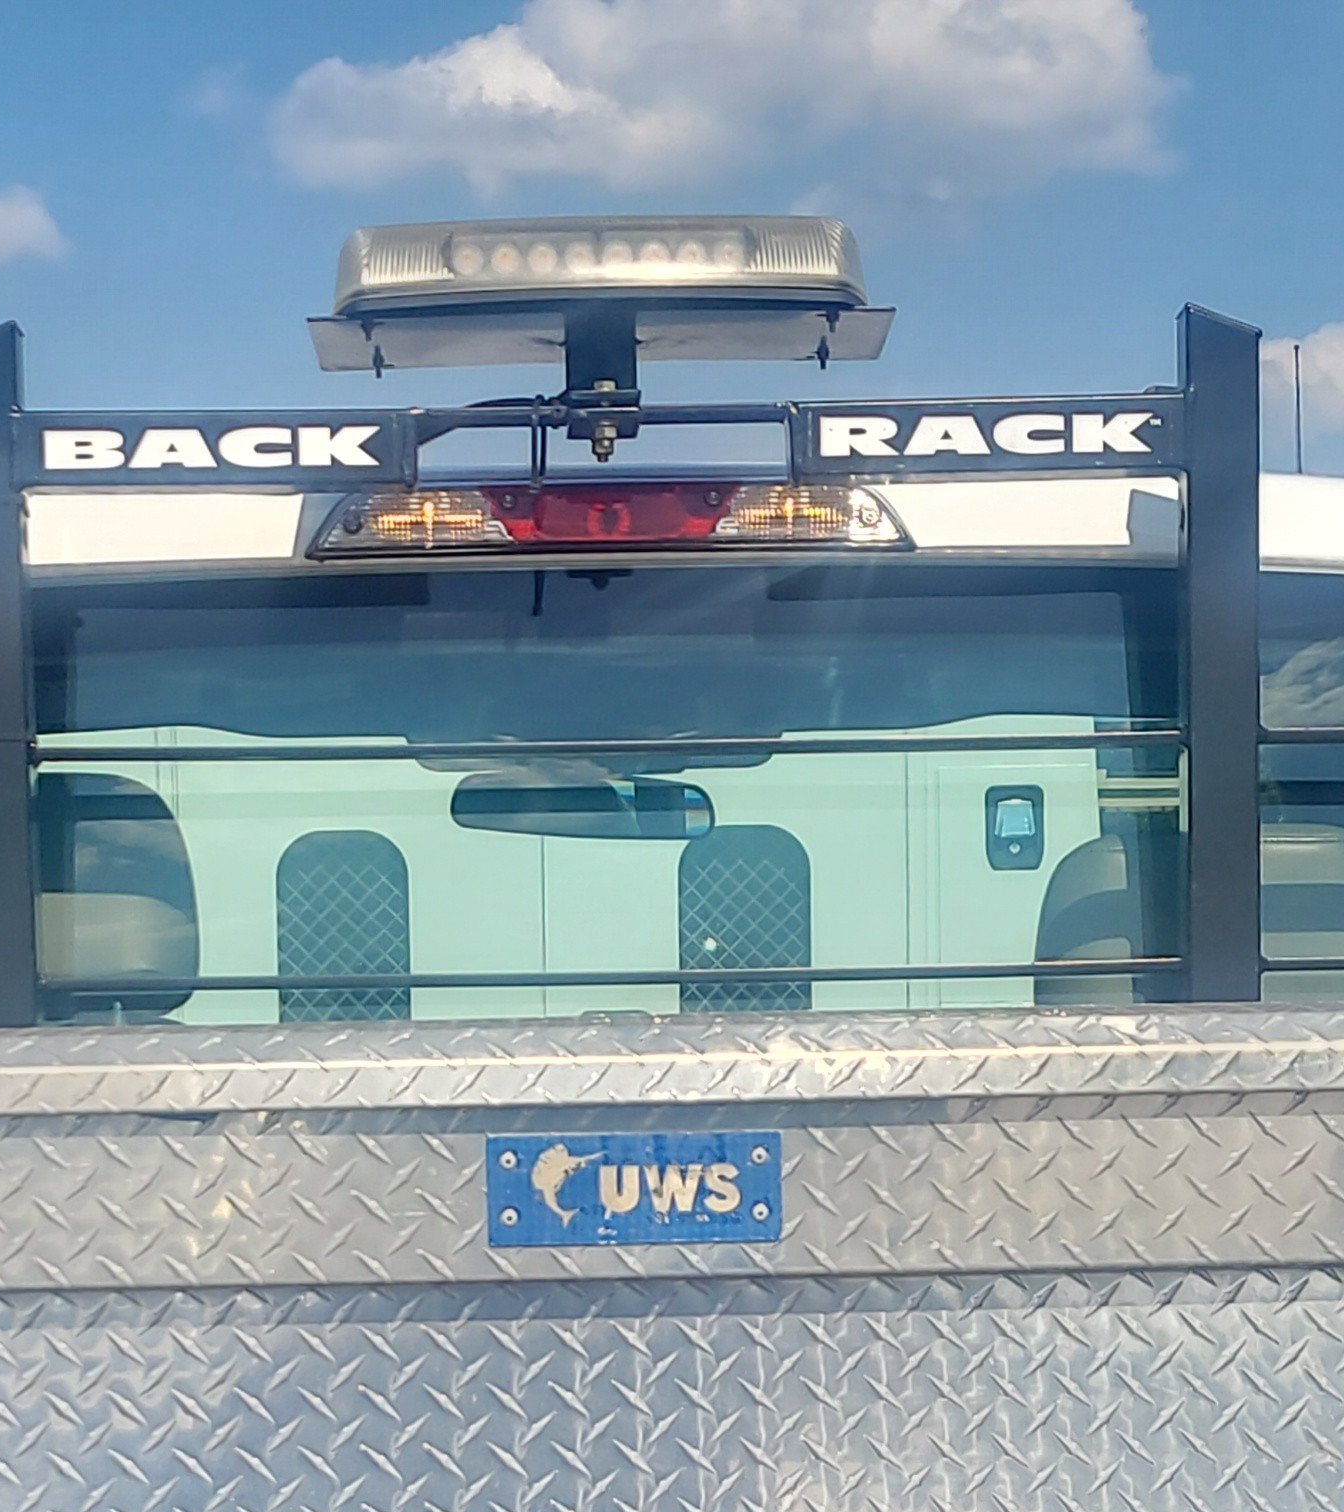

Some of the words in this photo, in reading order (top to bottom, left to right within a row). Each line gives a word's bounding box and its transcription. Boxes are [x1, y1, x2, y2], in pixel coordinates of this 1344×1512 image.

[42, 425, 381, 470] BACK
[818, 412, 1154, 457] RACK
[598, 1162, 742, 1214] UWS
